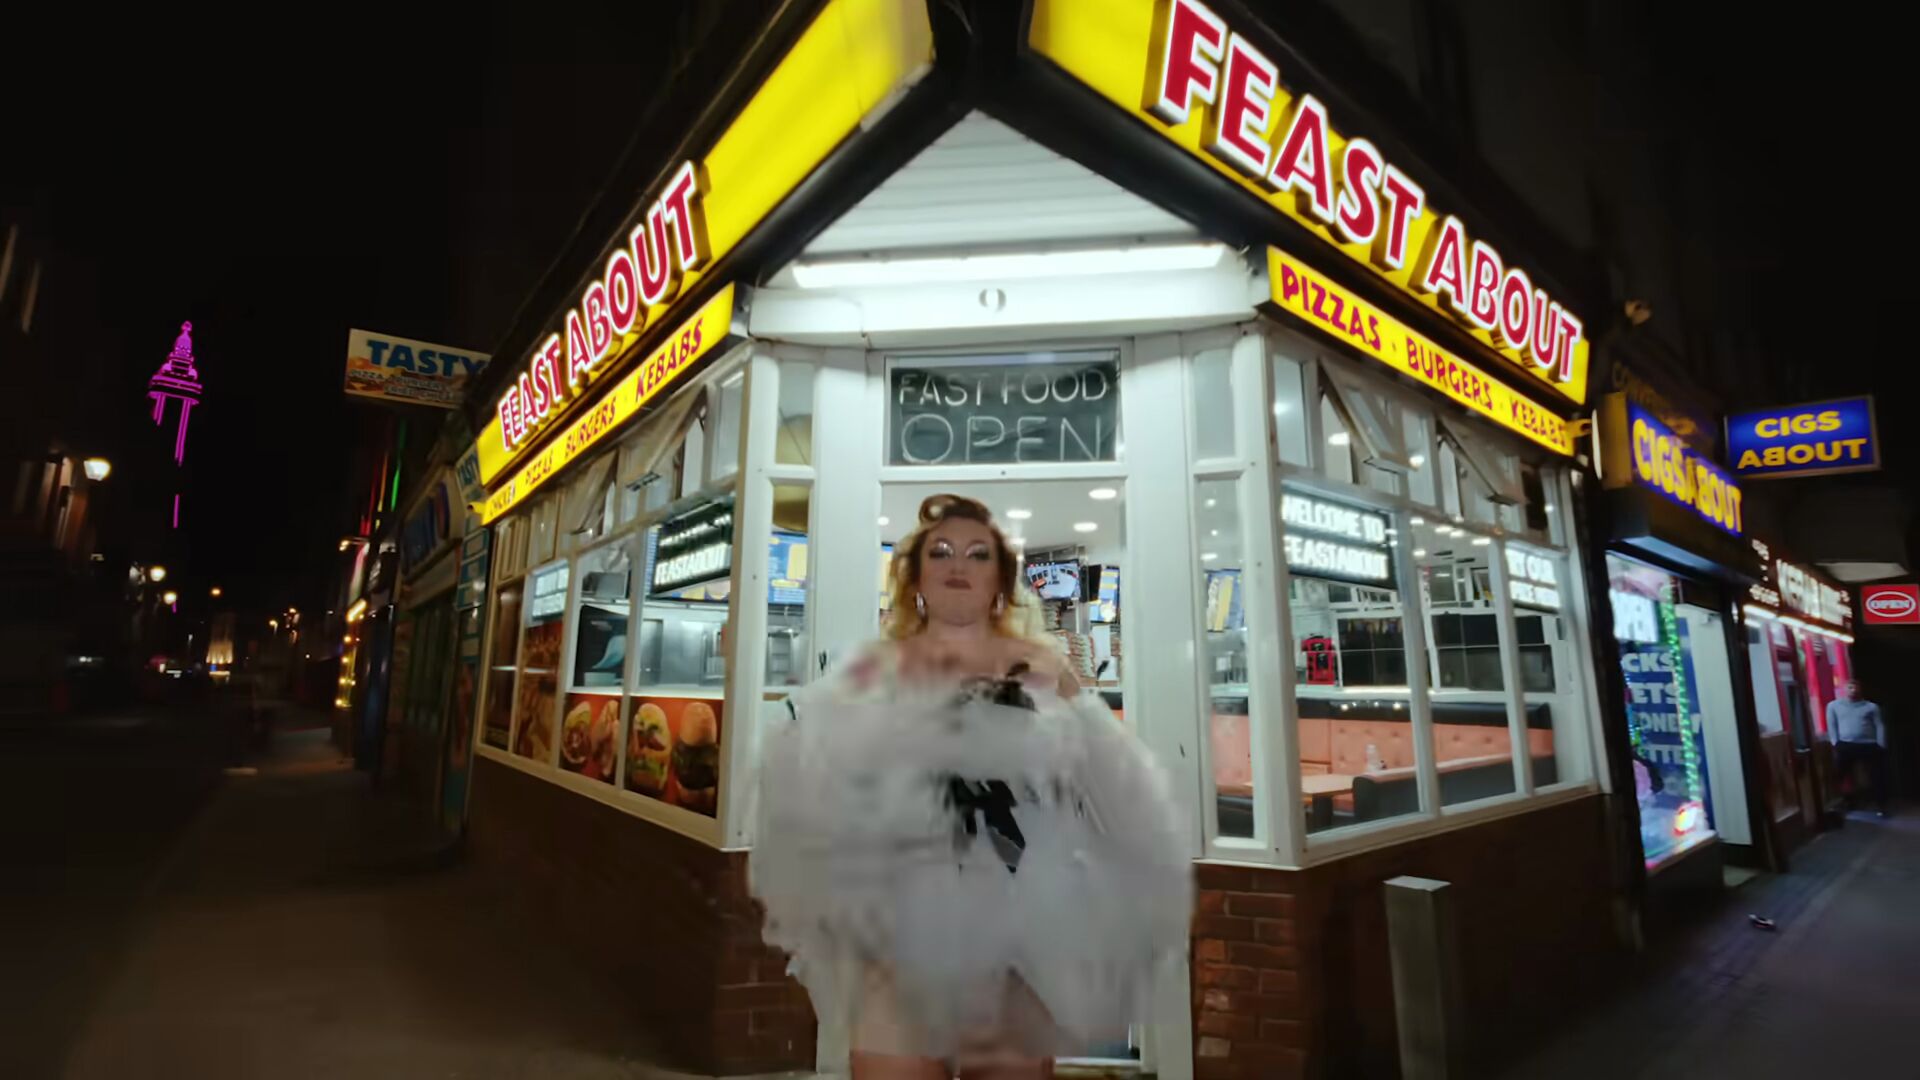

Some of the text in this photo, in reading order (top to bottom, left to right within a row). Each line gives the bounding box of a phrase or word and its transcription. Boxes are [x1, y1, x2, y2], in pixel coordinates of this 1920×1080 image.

[1159, 0, 1583, 382] FEAST ABOUT
[497, 160, 697, 452] FEAST ABOUT
[350, 368, 384, 380] PIZZA
[366, 338, 486, 378] TASTY
[1280, 262, 1382, 352] PIZZAS
[1405, 334, 1493, 410] BURGERS
[1508, 396, 1567, 449] KEBABS
[524, 447, 555, 486] PIZZAS
[563, 394, 618, 460] BURGERS
[635, 317, 704, 404] KEBABS
[898, 368, 1108, 407] FAST FOOD
[902, 412, 1101, 464] OPEN
[1755, 410, 1842, 439] CIGS
[1737, 437, 1867, 470] ABOUT
[1282, 494, 1386, 542] WELCOME TO
[1870, 599, 1910, 610] OPEN
